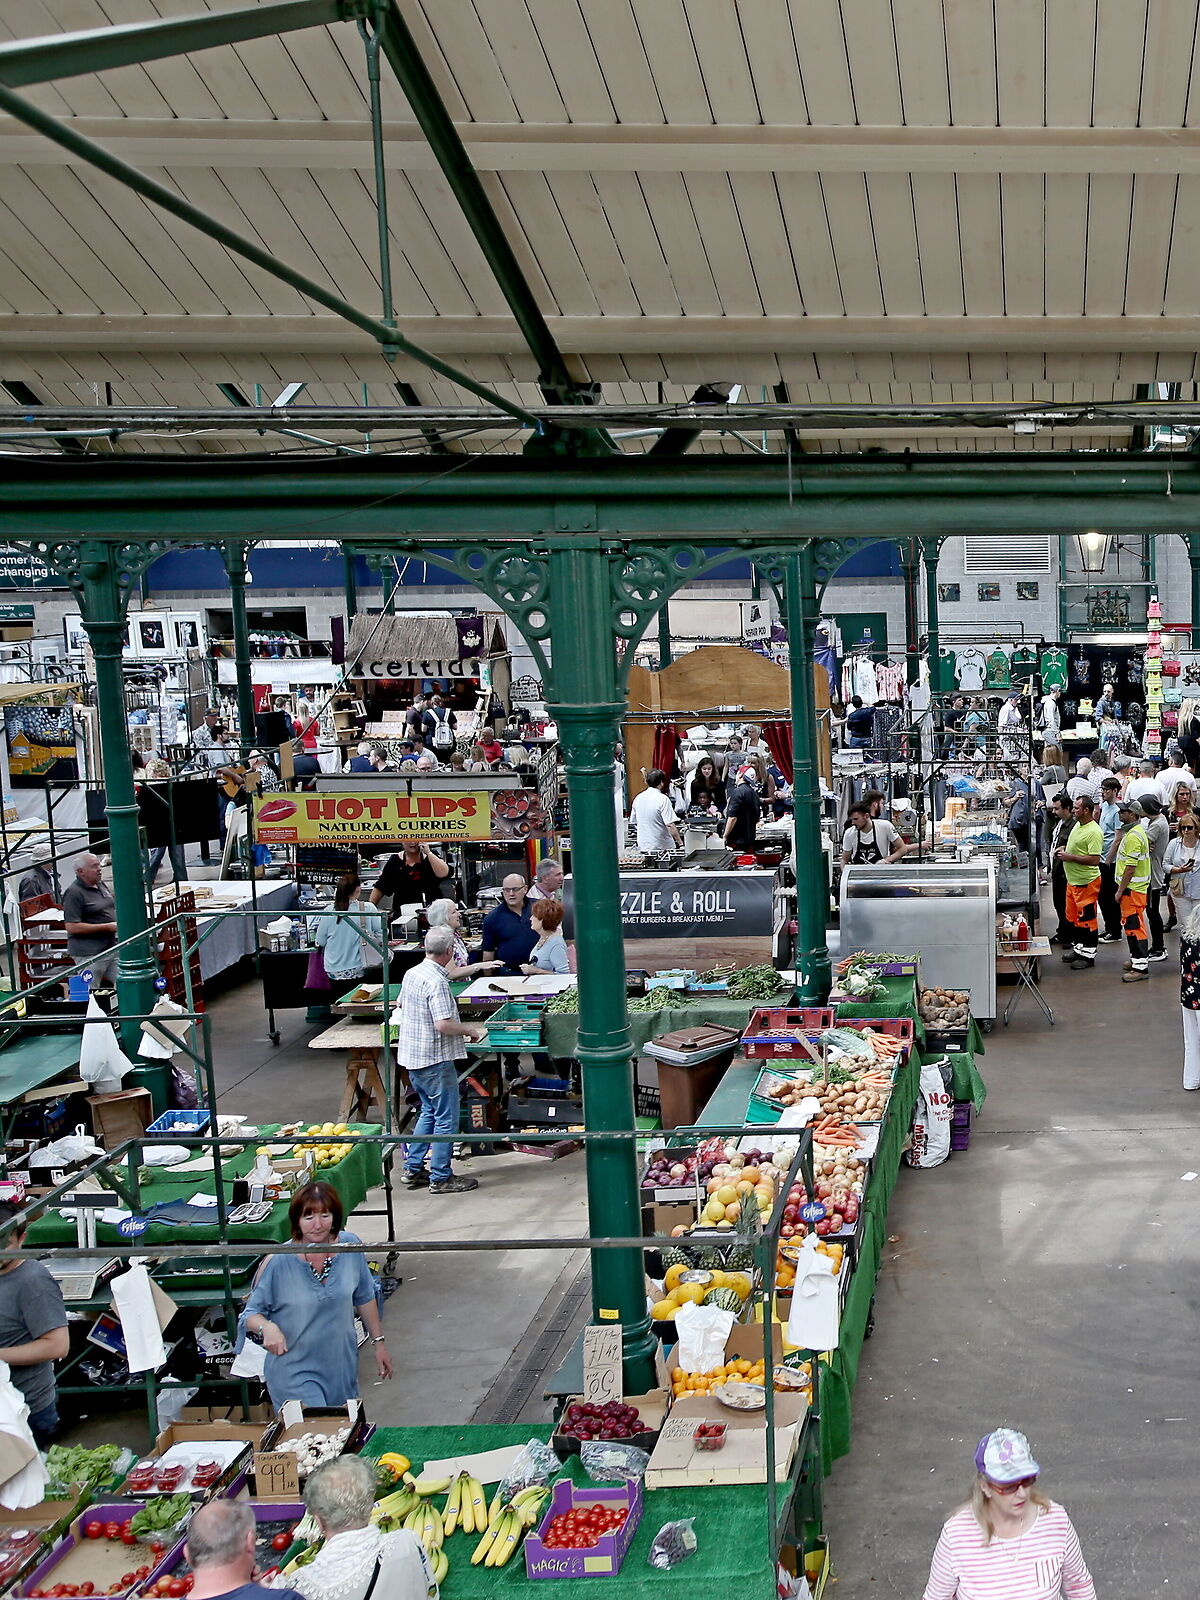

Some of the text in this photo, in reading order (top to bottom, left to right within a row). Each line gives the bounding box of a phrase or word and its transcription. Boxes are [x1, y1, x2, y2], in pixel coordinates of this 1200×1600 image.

[305, 797, 477, 820] HOT LIPS
[318, 820, 467, 832] NATURAL CURRIES
[620, 890, 736, 915] ZZLE & ROLL
[640, 915, 667, 924] BURGERS
[672, 915, 704, 923] BREAKFAST
[705, 914, 724, 922] MENU
